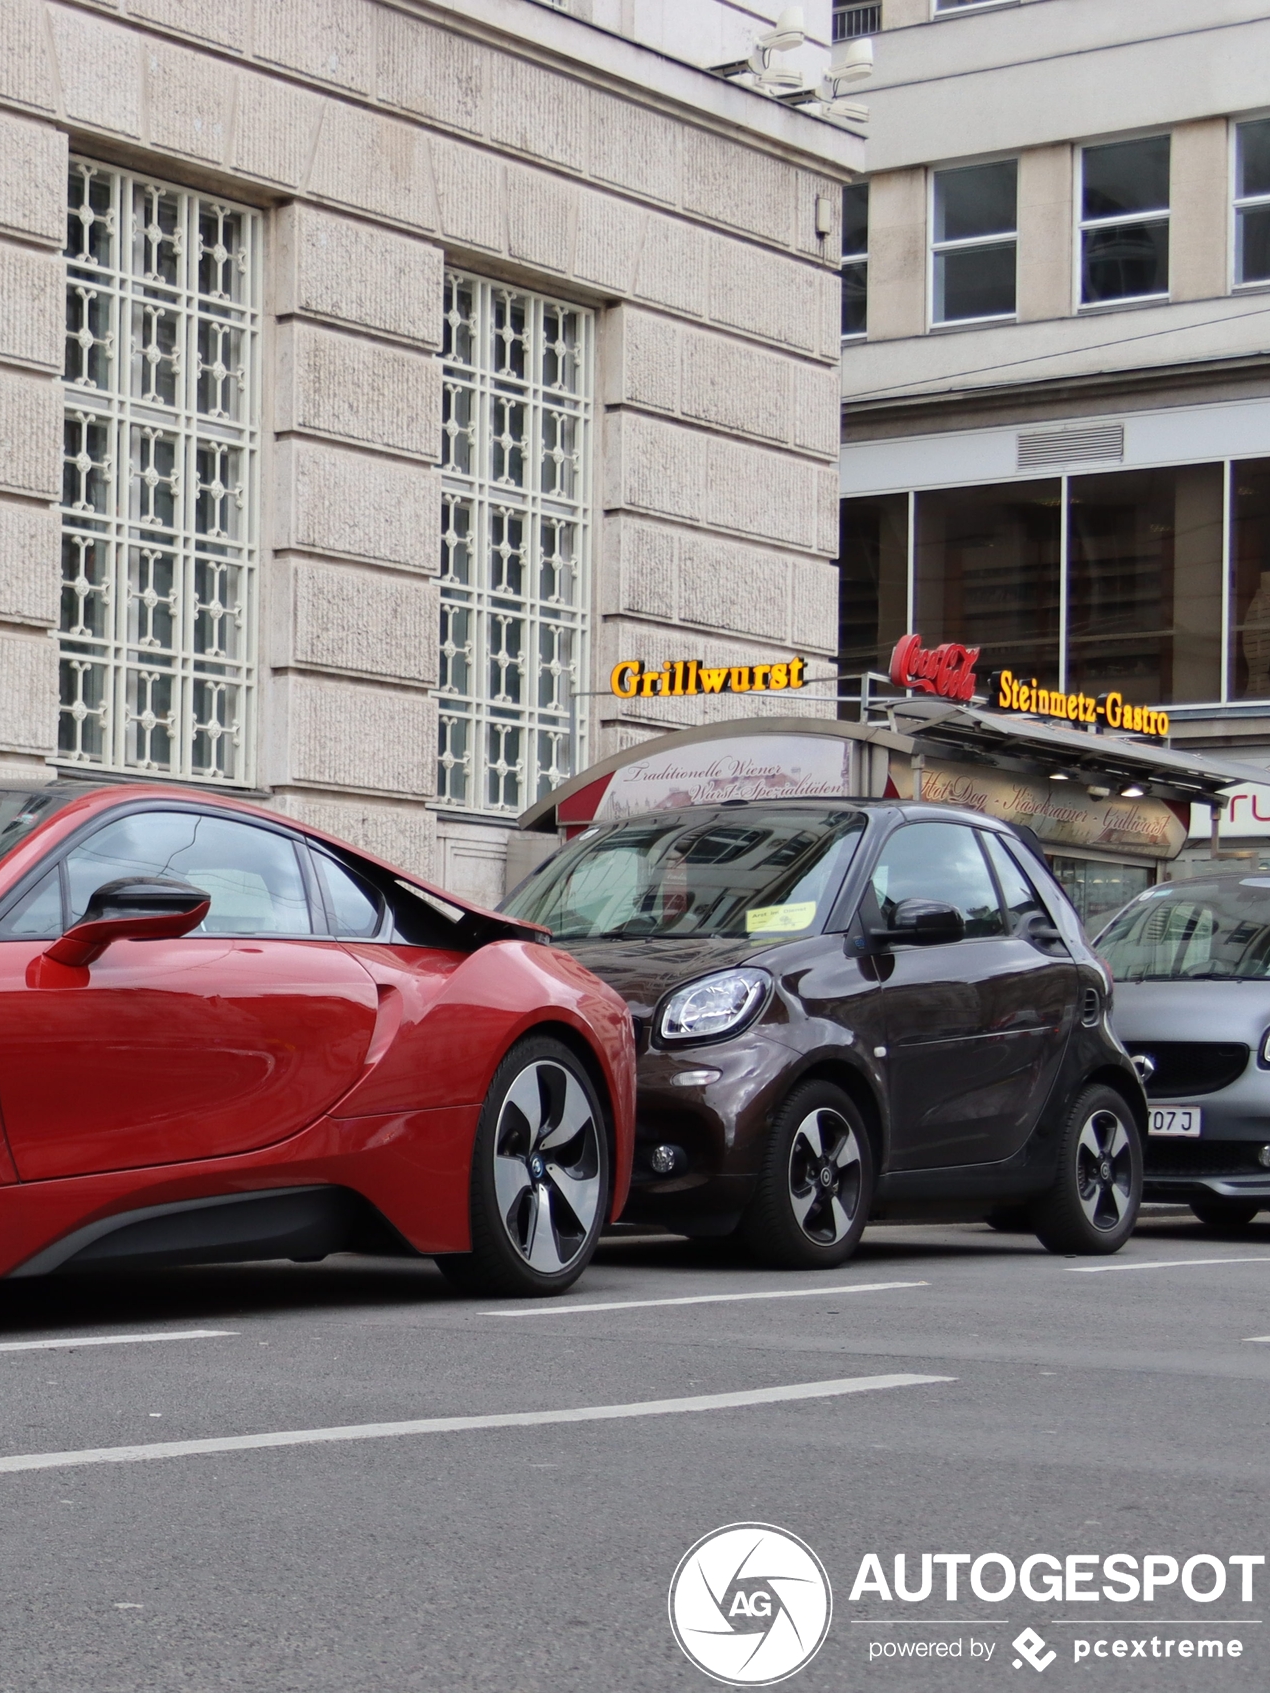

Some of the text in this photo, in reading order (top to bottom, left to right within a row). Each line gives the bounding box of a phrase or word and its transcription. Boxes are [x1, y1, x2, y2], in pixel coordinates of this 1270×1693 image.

[610, 656, 805, 699] Grillwurst
[999, 669, 1170, 736] Steinmetz-Gastro
[623, 755, 783, 782] Traditionelle Wiener
[688, 773, 843, 800] Wurst-Spezialitäten
[920, 769, 952, 801] Hot
[948, 775, 988, 812] Dog
[1002, 784, 1088, 823] Käsekrainer
[1101, 802, 1172, 840] Grillwurst
